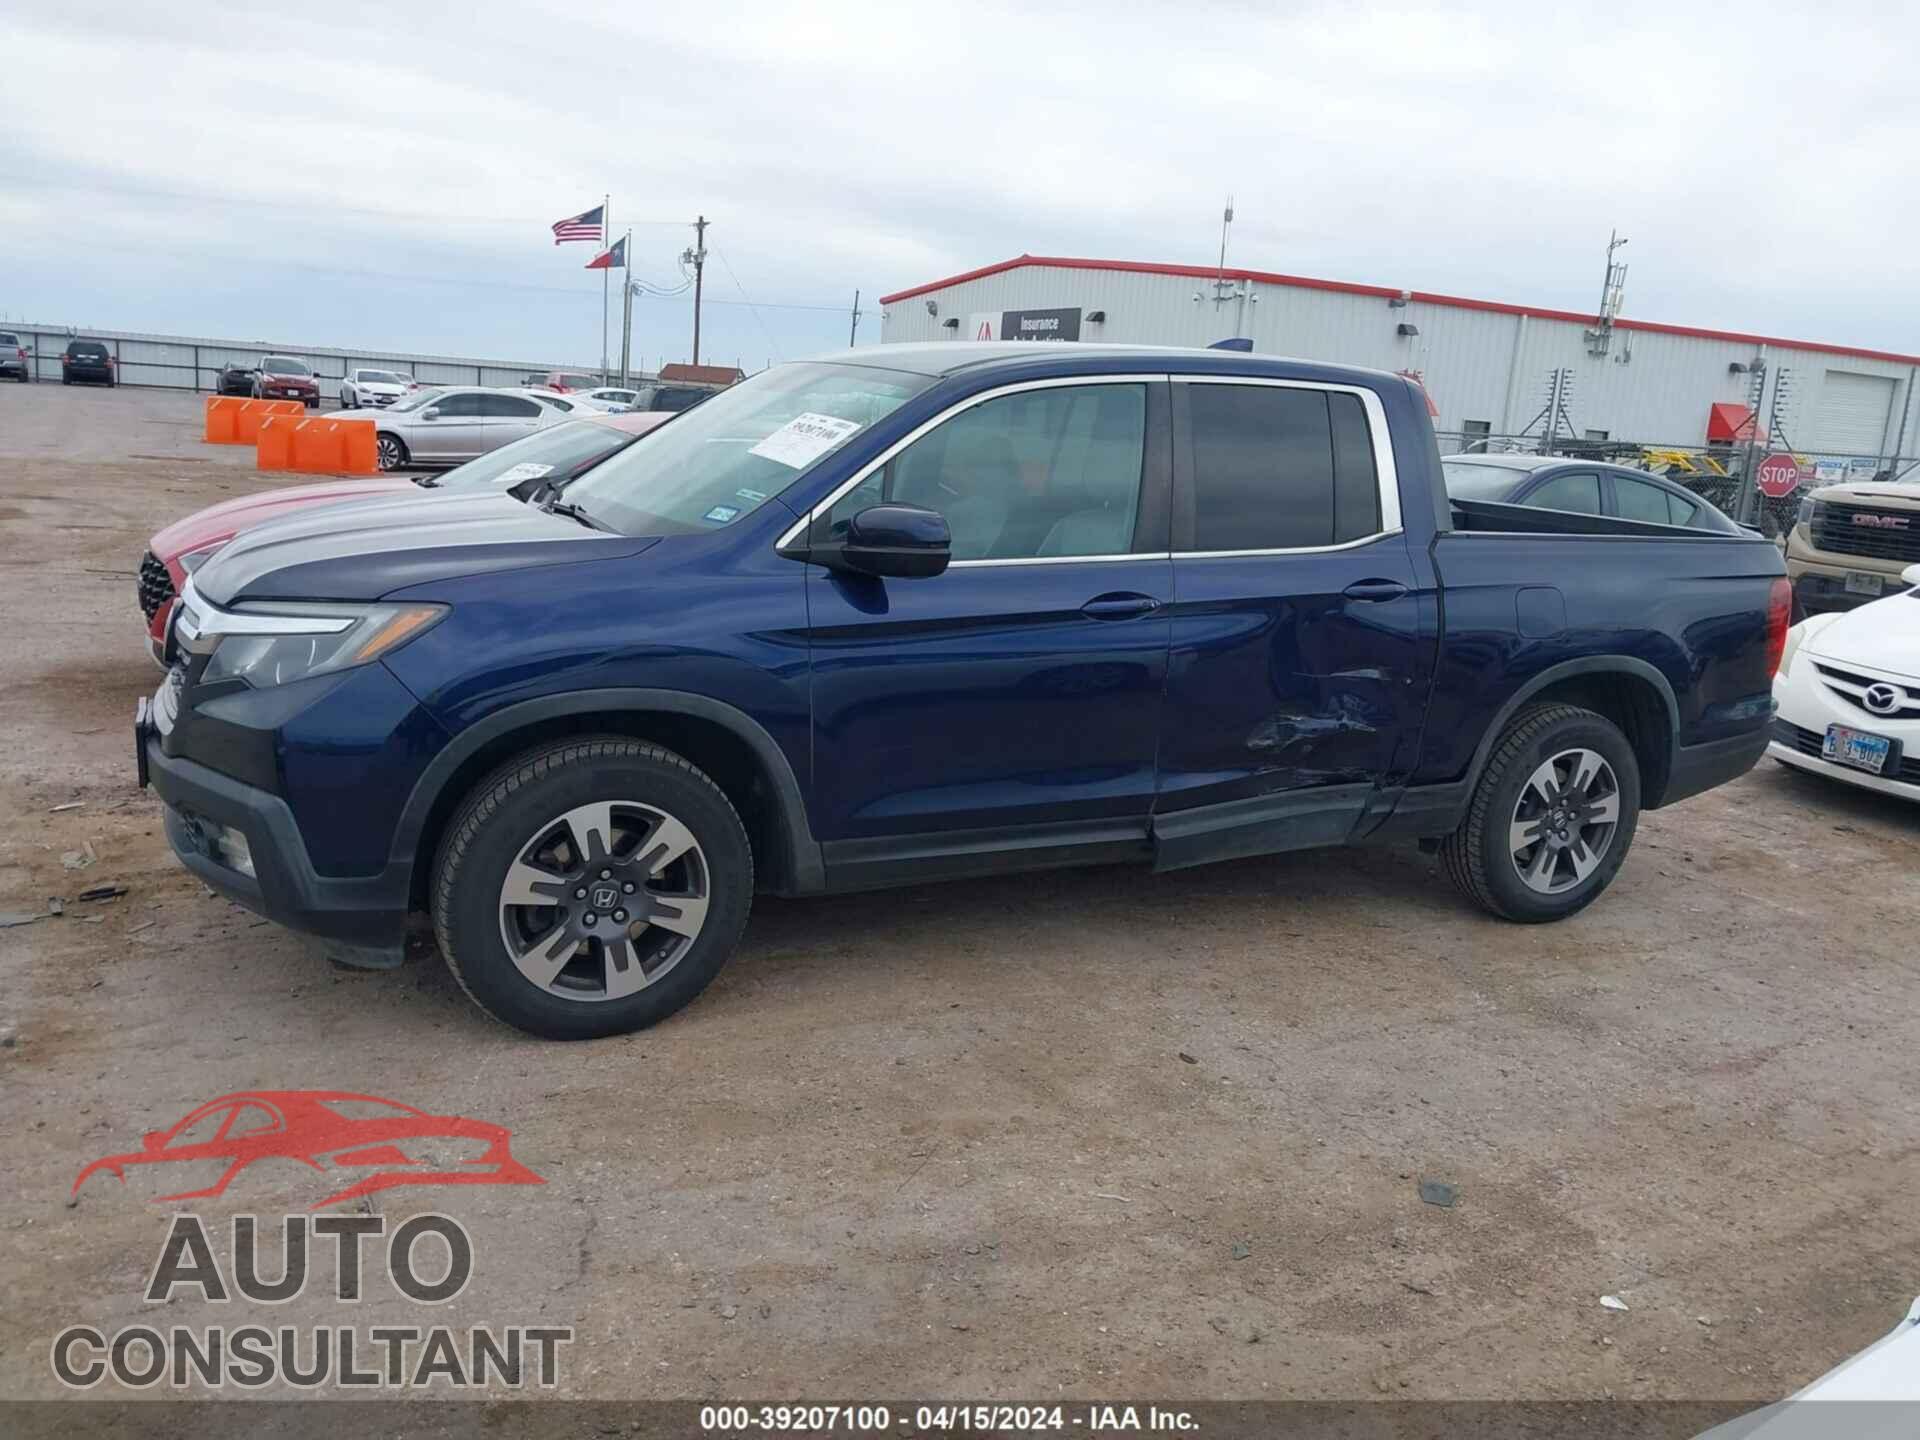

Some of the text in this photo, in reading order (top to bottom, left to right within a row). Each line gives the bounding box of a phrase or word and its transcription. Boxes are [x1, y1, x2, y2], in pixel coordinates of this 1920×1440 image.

[1020, 316, 1059, 330] Insurance
[1762, 467, 1795, 483] STOP
[1852, 514, 1910, 529] GMC
